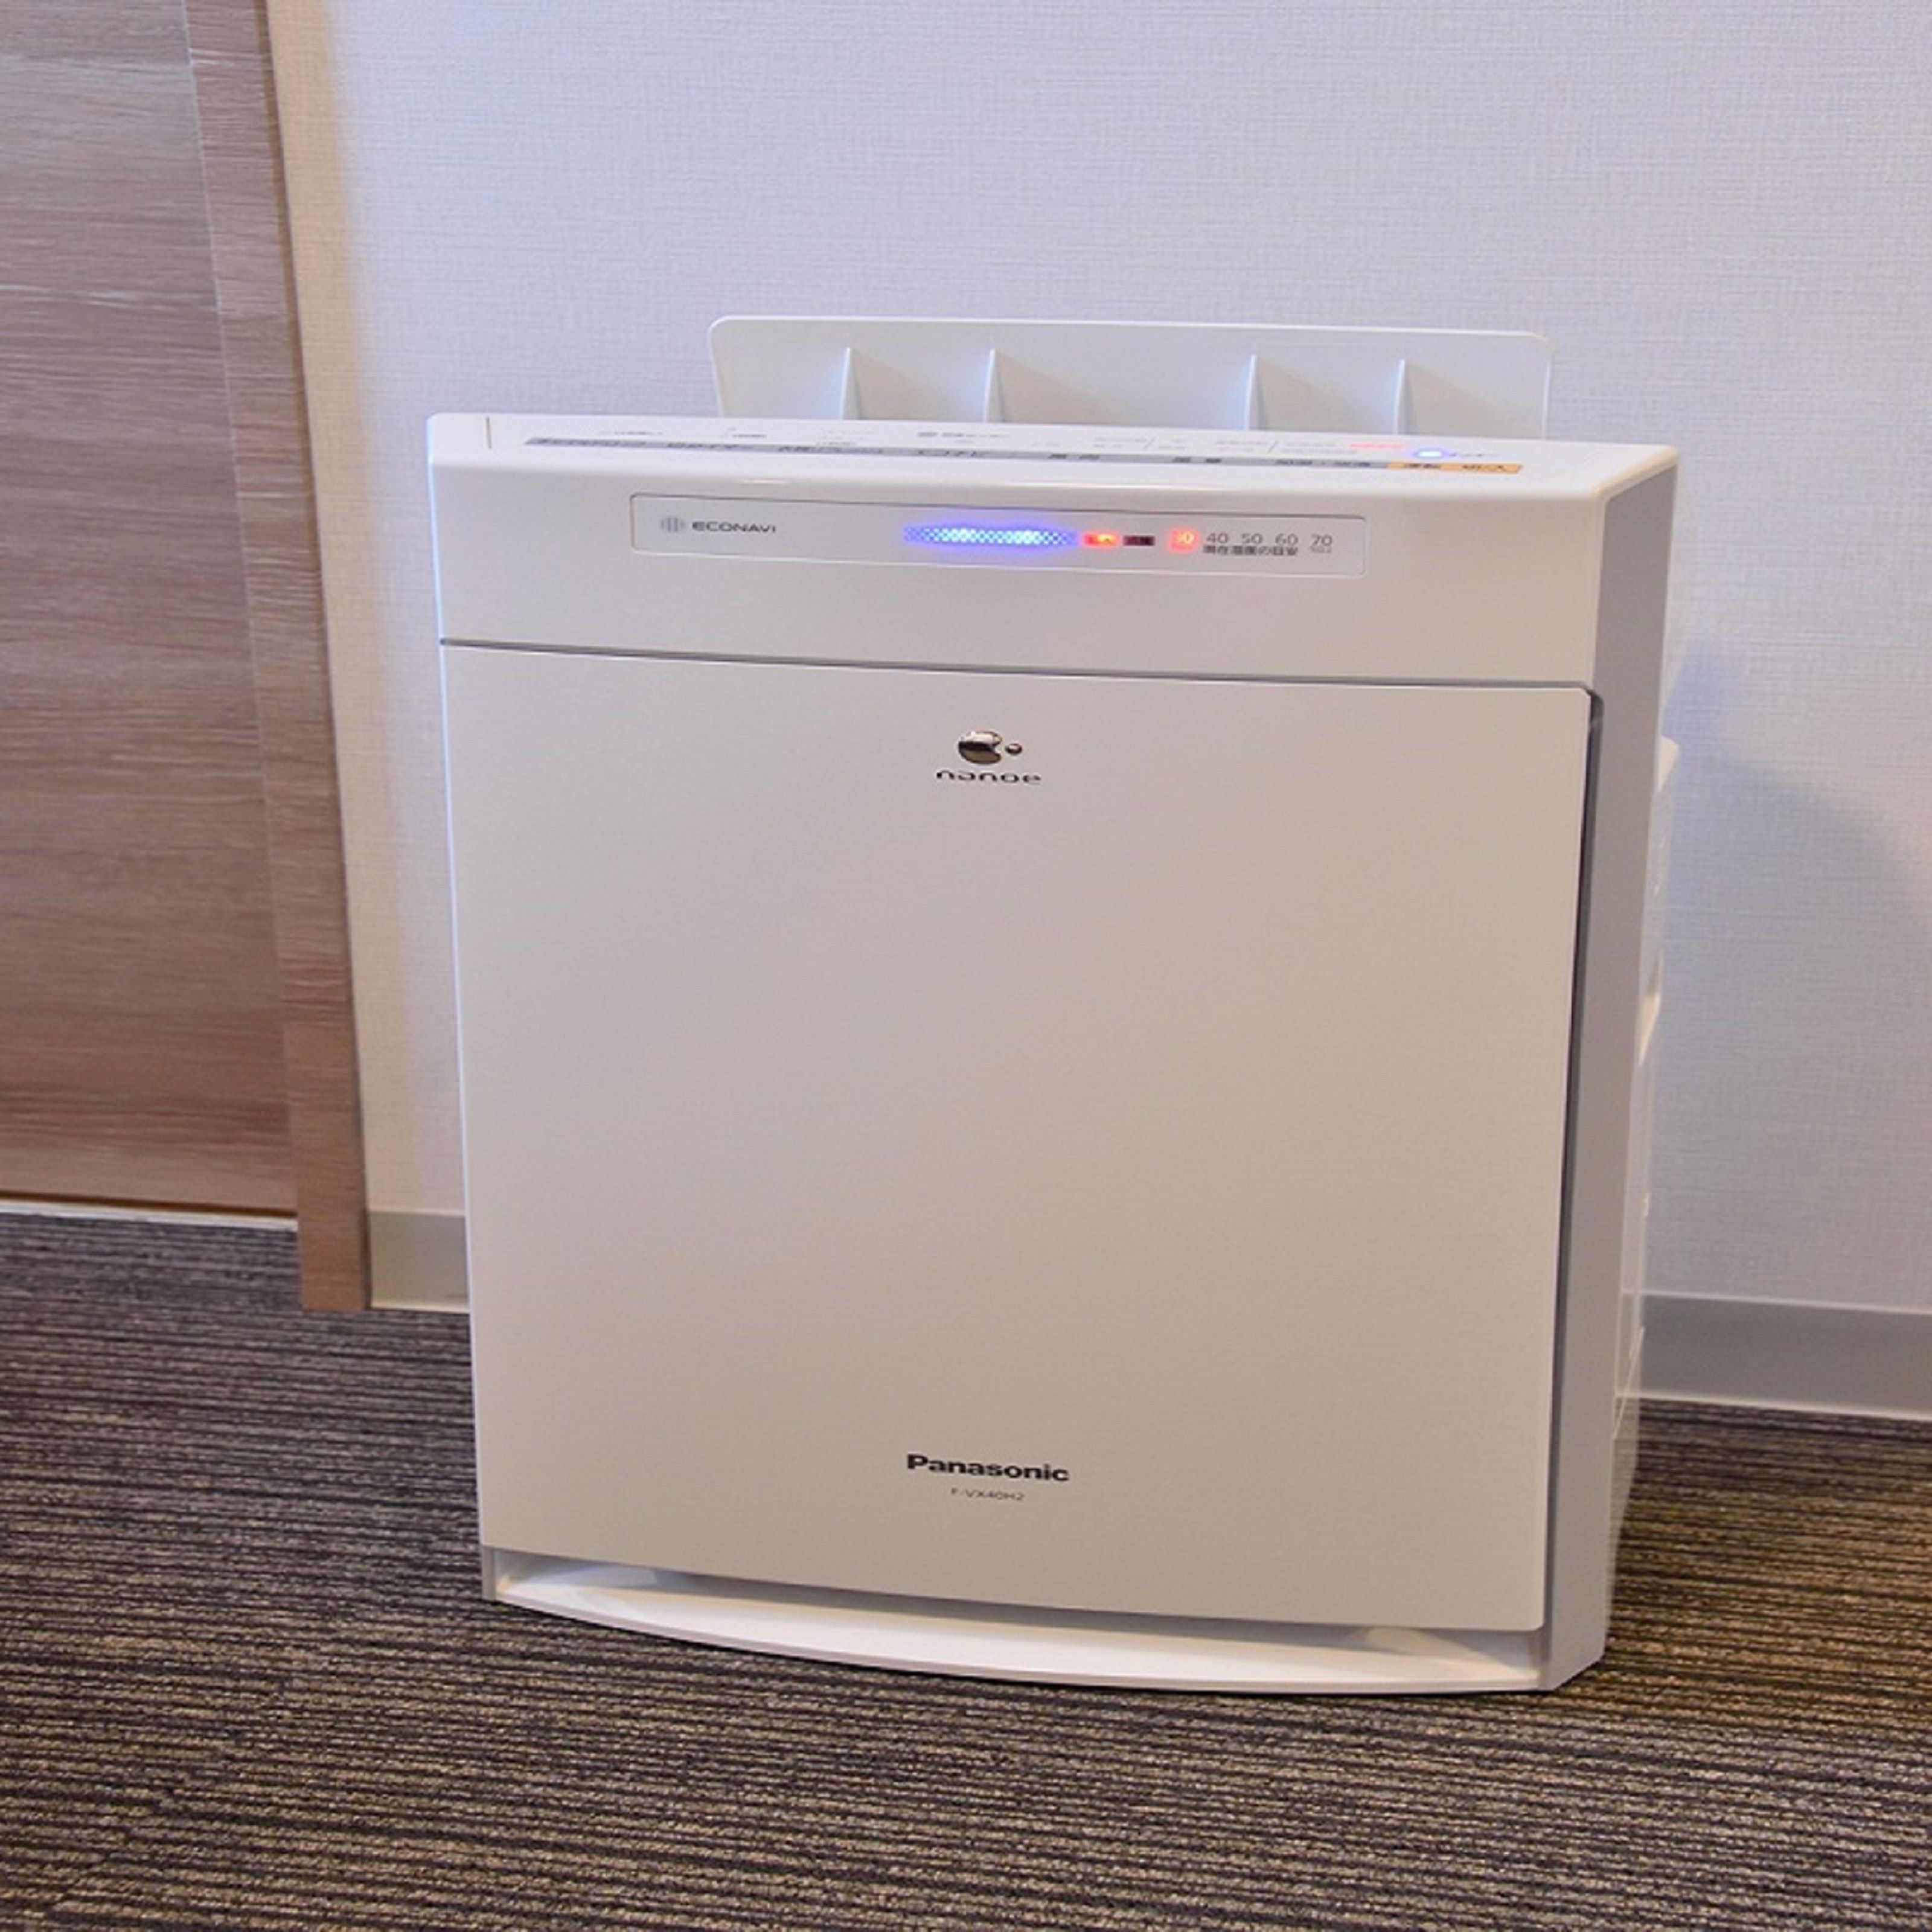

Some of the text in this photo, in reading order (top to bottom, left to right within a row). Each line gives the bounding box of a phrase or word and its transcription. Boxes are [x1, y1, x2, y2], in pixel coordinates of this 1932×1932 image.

[692, 522, 776, 533] ECONAVI
[1206, 533, 1229, 544] 40
[1241, 533, 1263, 545] 50
[1275, 533, 1298, 545] 60
[1311, 534, 1332, 546] 70
[936, 770, 1041, 784] nanoe
[907, 1453, 1069, 1481] Panasonic
